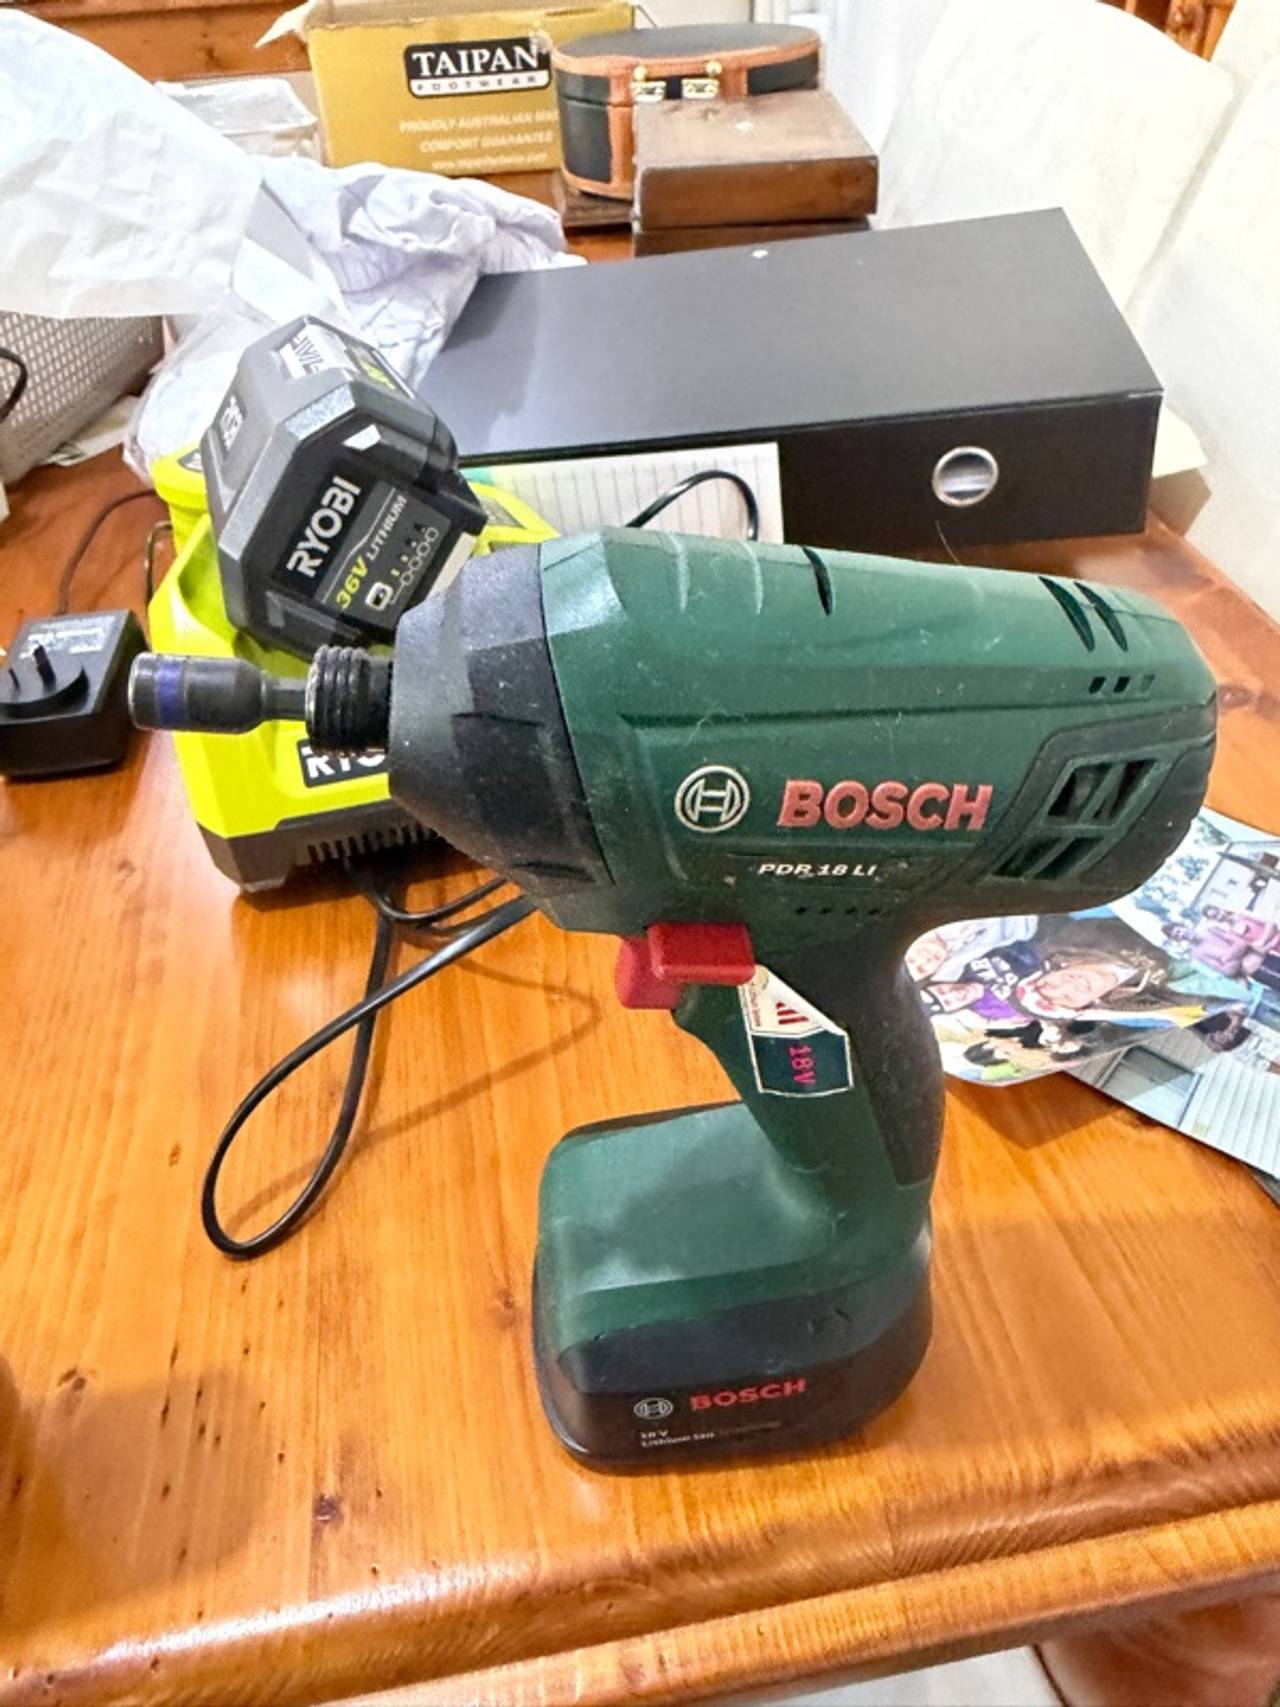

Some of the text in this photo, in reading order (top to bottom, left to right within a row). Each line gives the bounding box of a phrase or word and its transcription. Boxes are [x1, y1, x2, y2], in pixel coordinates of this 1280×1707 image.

[412, 42, 539, 76] TAIPAN
[286, 475, 361, 578] RYOBI
[336, 494, 407, 610] 36V LITHIUM
[777, 778, 993, 831] BOSCH
[757, 863, 878, 876] PDR 18 LI
[788, 1044, 817, 1085] 18V
[690, 1378, 806, 1412] BOSCH
